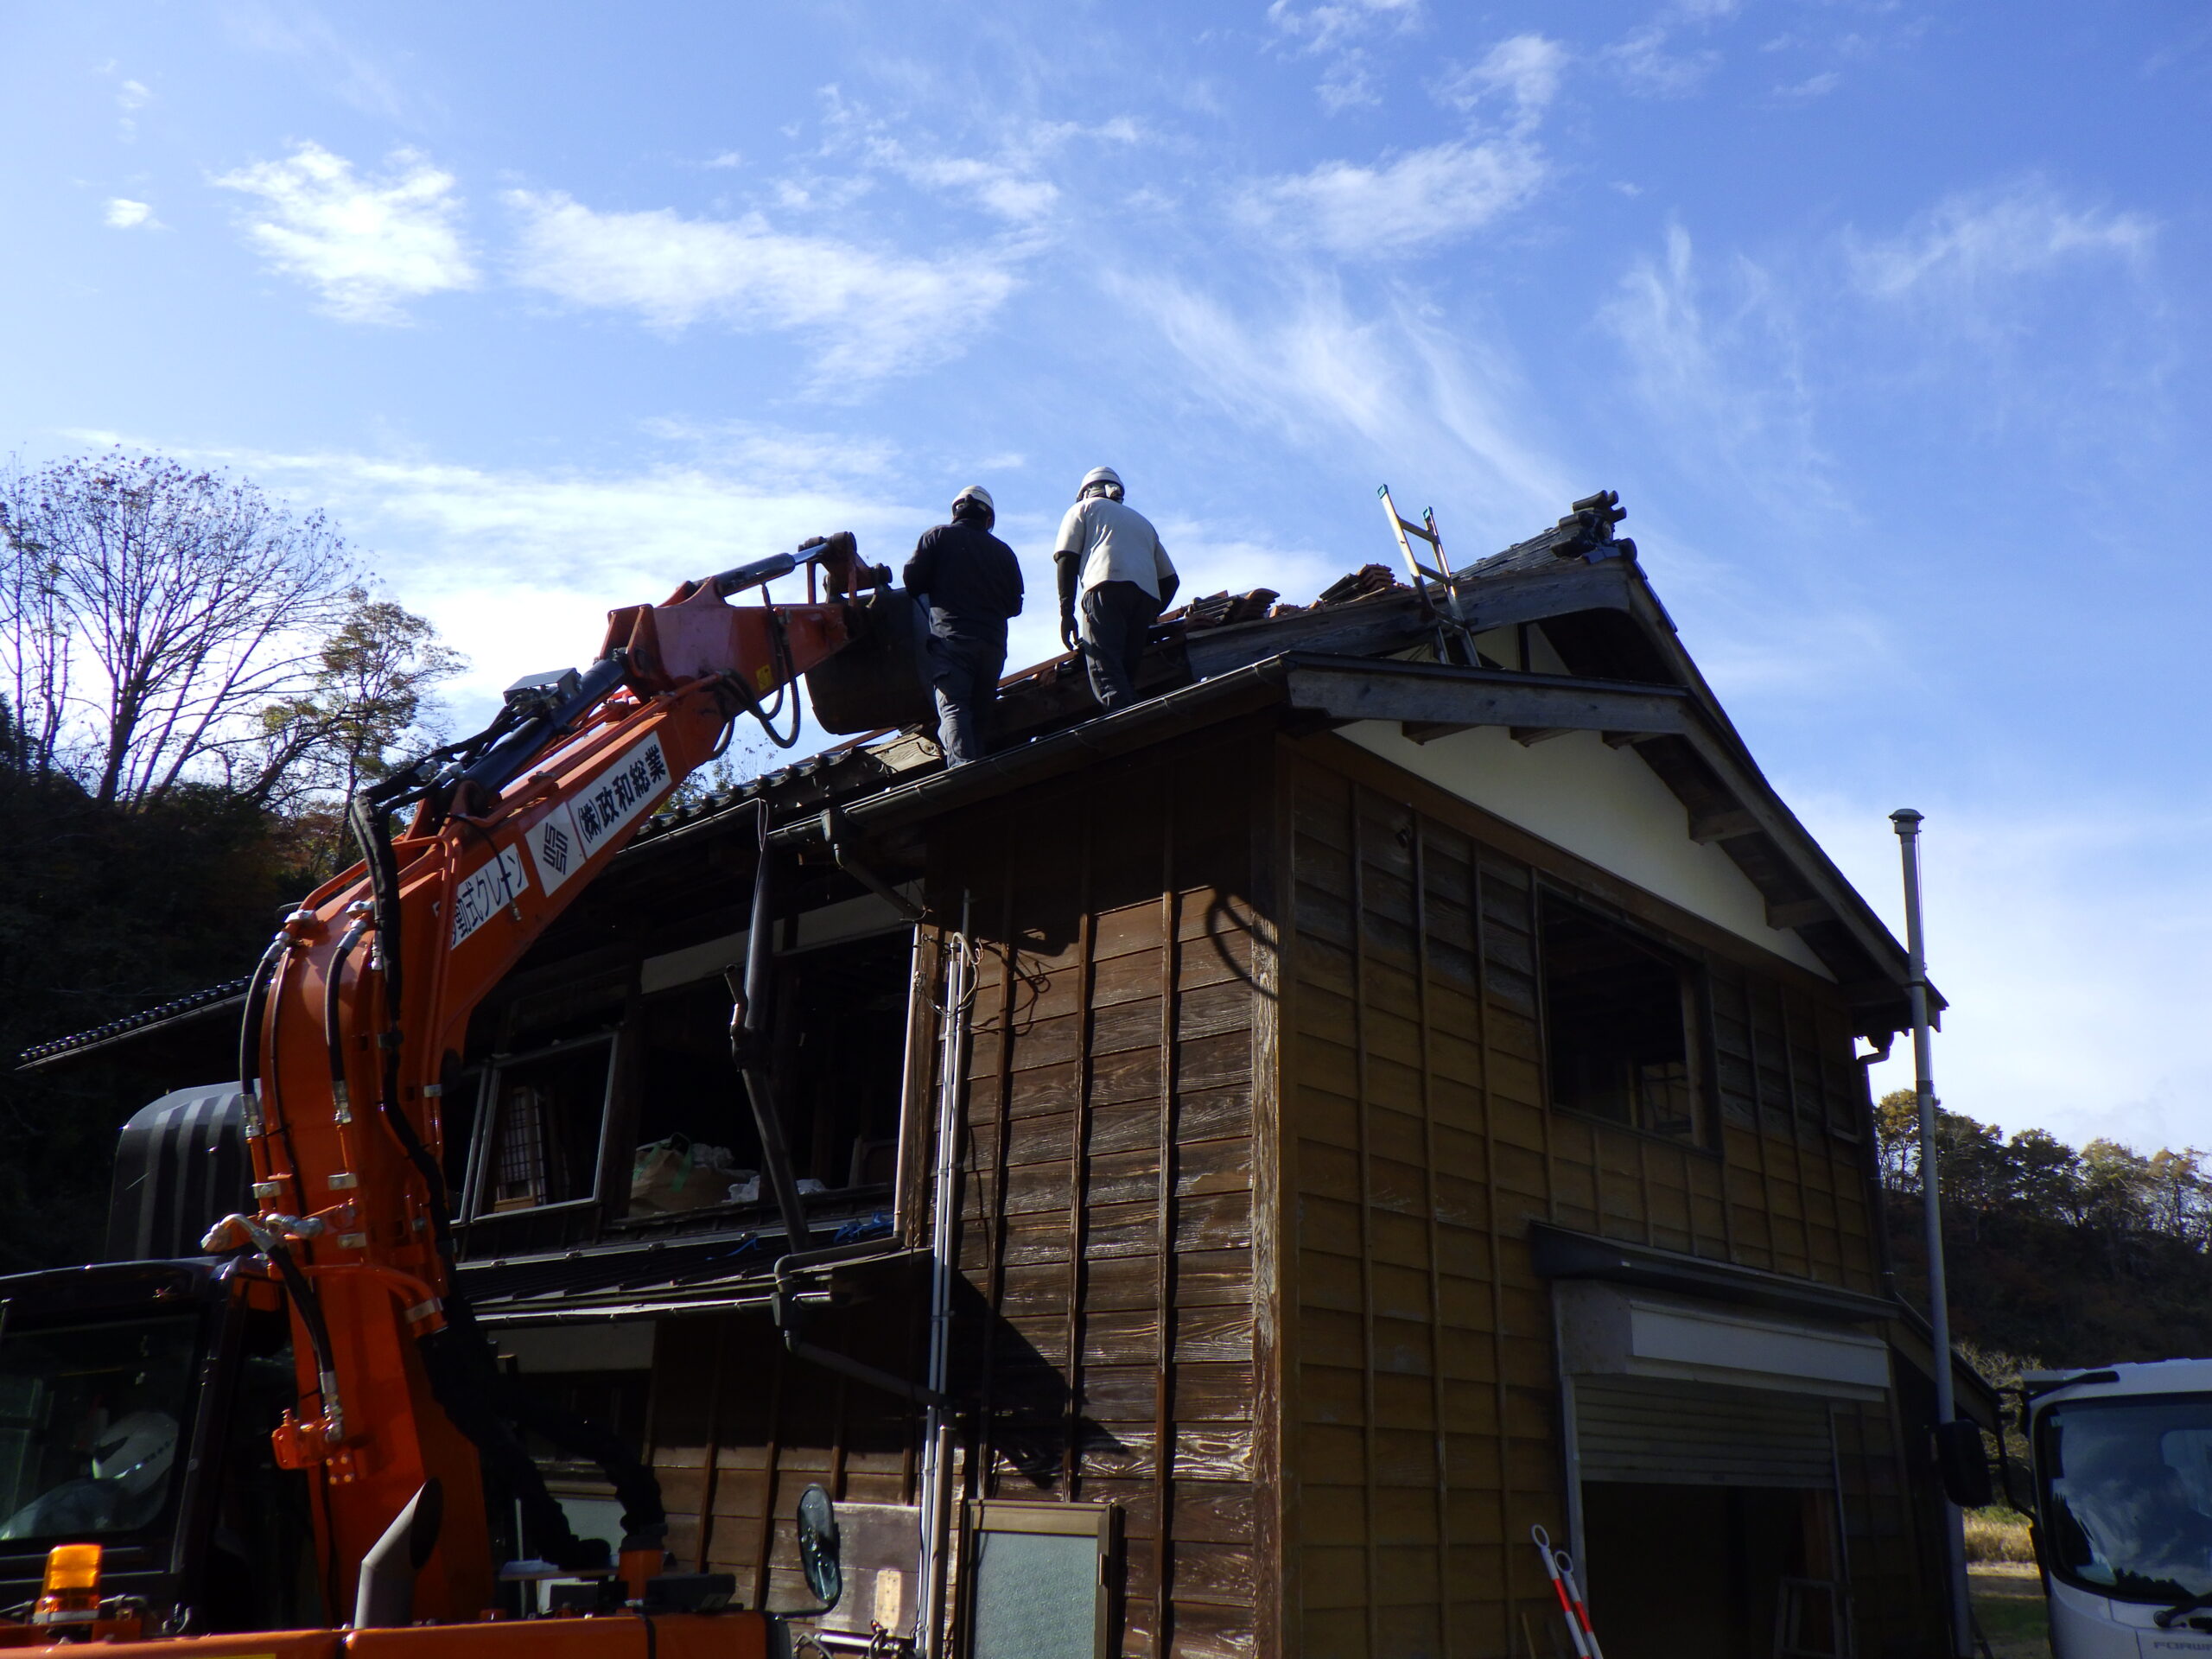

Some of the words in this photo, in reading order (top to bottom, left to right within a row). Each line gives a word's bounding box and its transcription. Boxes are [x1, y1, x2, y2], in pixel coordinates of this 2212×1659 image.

[437, 853, 522, 945] 動式クレーン
